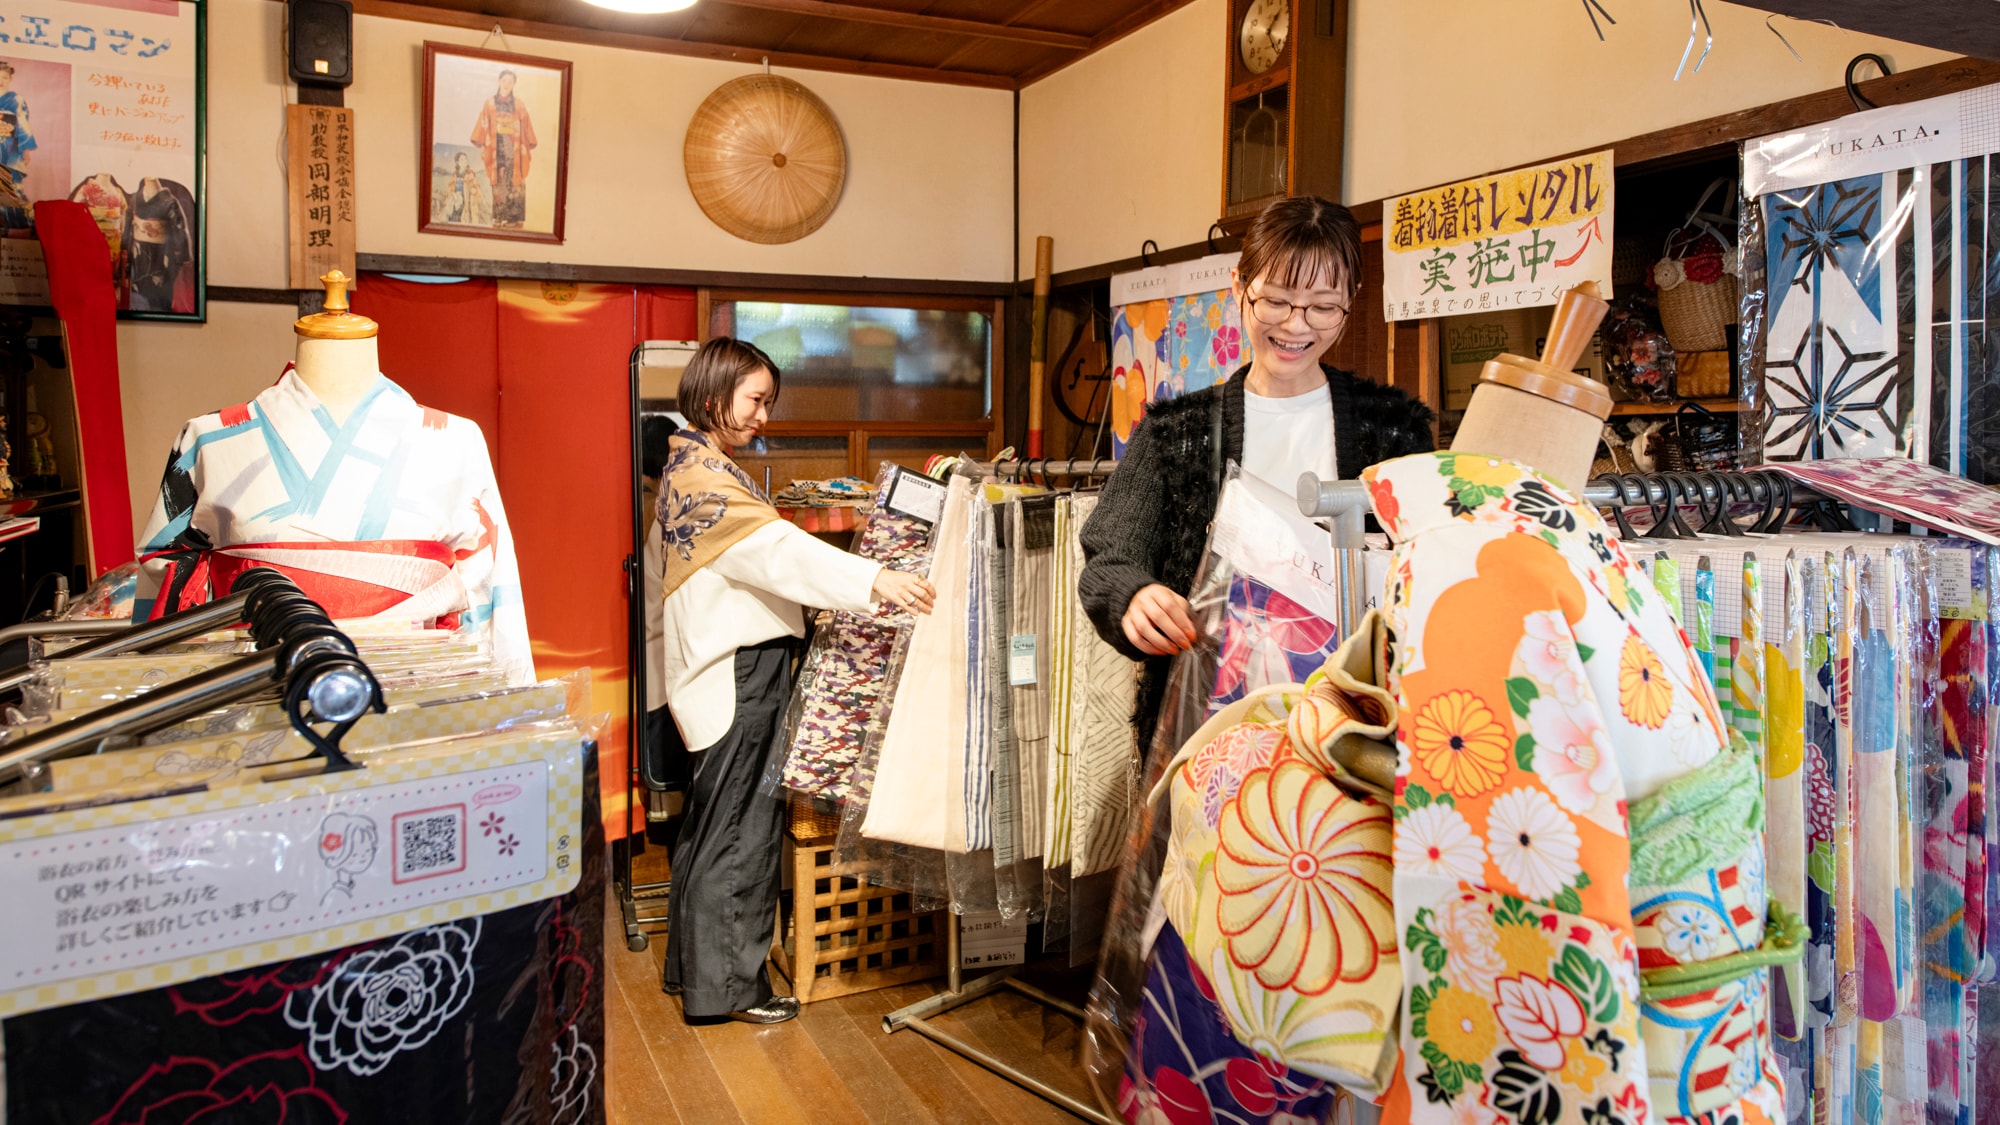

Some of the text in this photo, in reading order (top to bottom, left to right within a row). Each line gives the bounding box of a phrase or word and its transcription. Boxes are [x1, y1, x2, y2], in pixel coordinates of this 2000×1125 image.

[1394, 162, 1601, 249] 着物着付レンタル
[1130, 276, 1167, 291] YUKATA
[1189, 265, 1231, 281] YUKATA
[1419, 228, 1556, 296] 実施中
[55, 884, 219, 929] 浴衣の楽しみ方を
[55, 898, 266, 954] 詳しくご紹介しています
